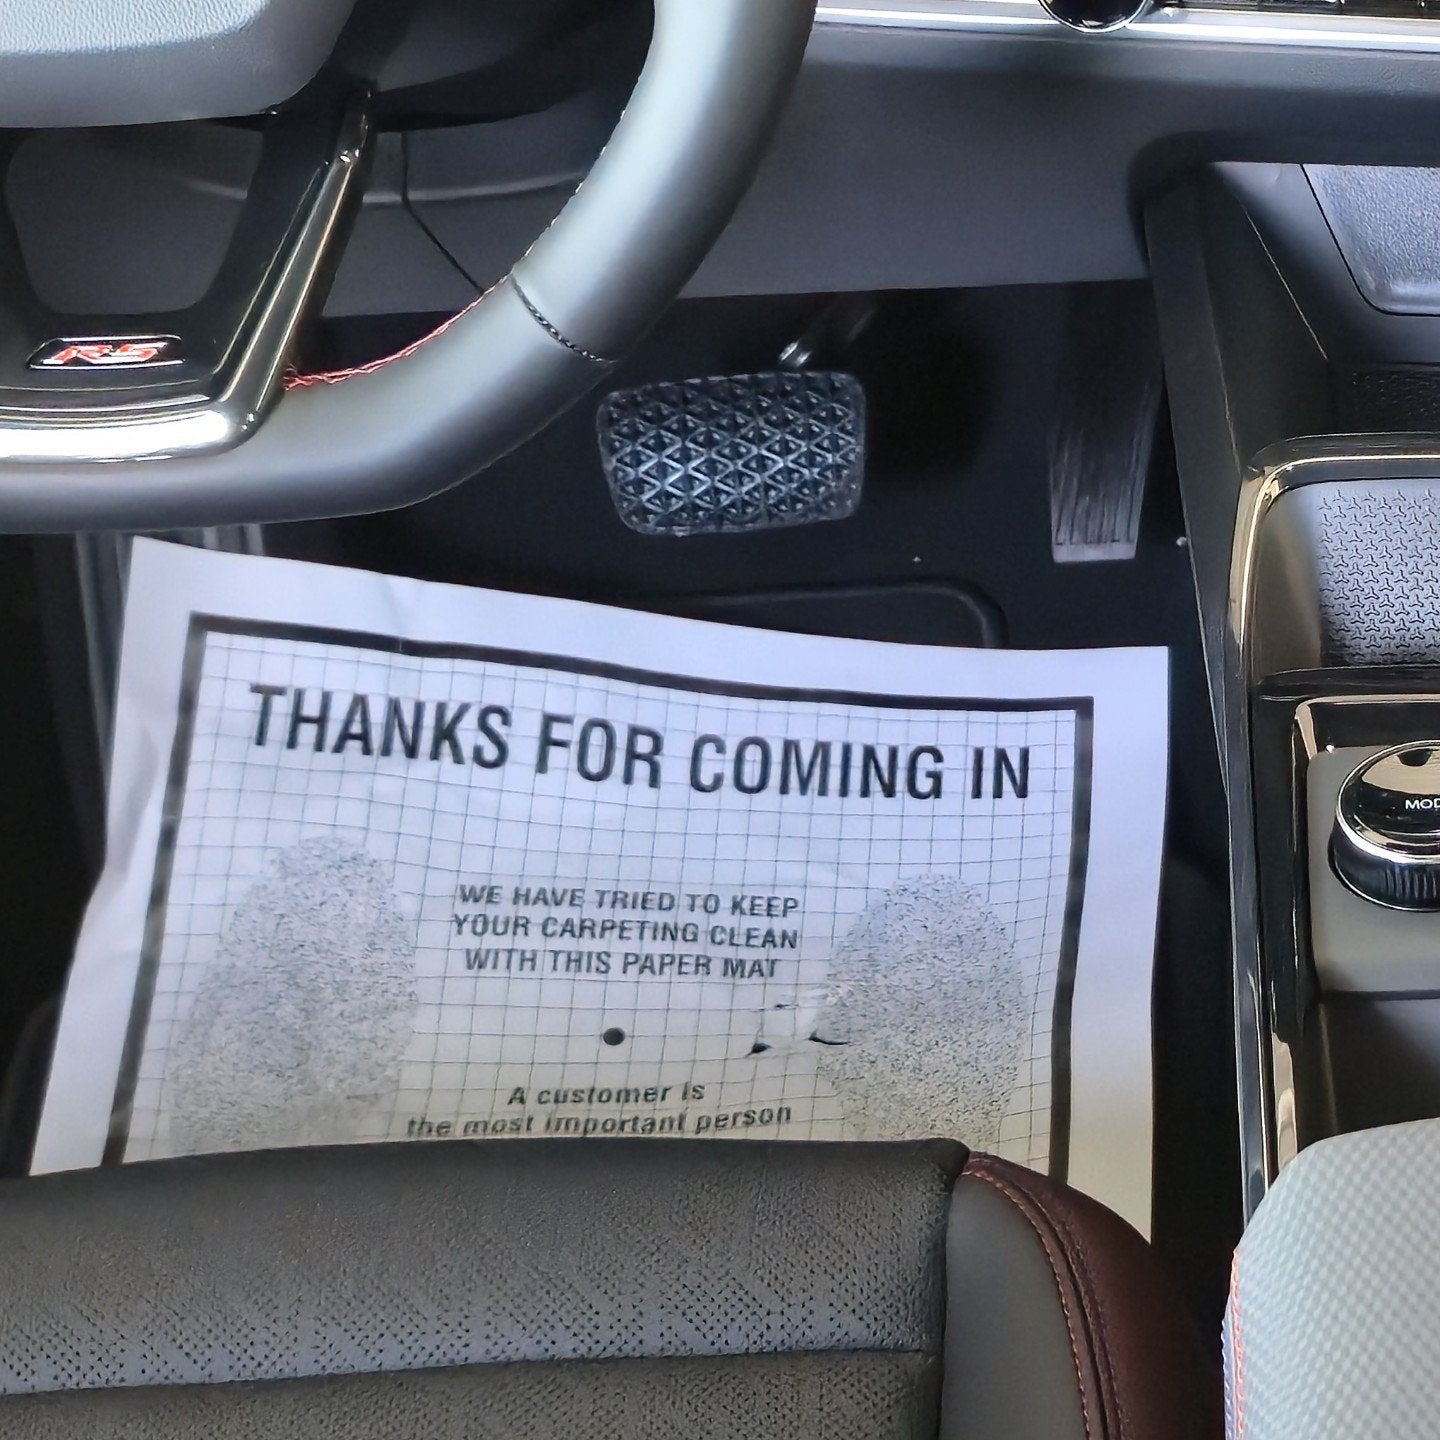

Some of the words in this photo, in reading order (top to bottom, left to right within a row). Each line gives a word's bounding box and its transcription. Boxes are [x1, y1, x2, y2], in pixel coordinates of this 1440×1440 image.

[42, 341, 169, 365] RS
[249, 683, 513, 770] THANKS
[536, 711, 665, 790] FOR
[689, 732, 945, 800] COMING
[970, 745, 1031, 800] IN
[459, 883, 503, 905] WE
[512, 886, 586, 909] HAVE
[594, 888, 676, 913] TRIED
[686, 893, 720, 914] TO
[730, 894, 800, 919] KEEP
[453, 913, 531, 938] YOUR
[540, 915, 700, 943] CARPETING
[710, 923, 798, 950] CLEAN
[464, 947, 538, 973] WITH
[549, 949, 612, 975] THIS
[621, 951, 714, 978] PAPER
[722, 957, 781, 979] MAT
[507, 1086, 527, 1106] A
[537, 1082, 673, 1106] customer
[406, 1117, 452, 1138] the
[463, 1115, 534, 1135] most
[545, 1111, 687, 1137] important
[695, 1105, 793, 1135] person
